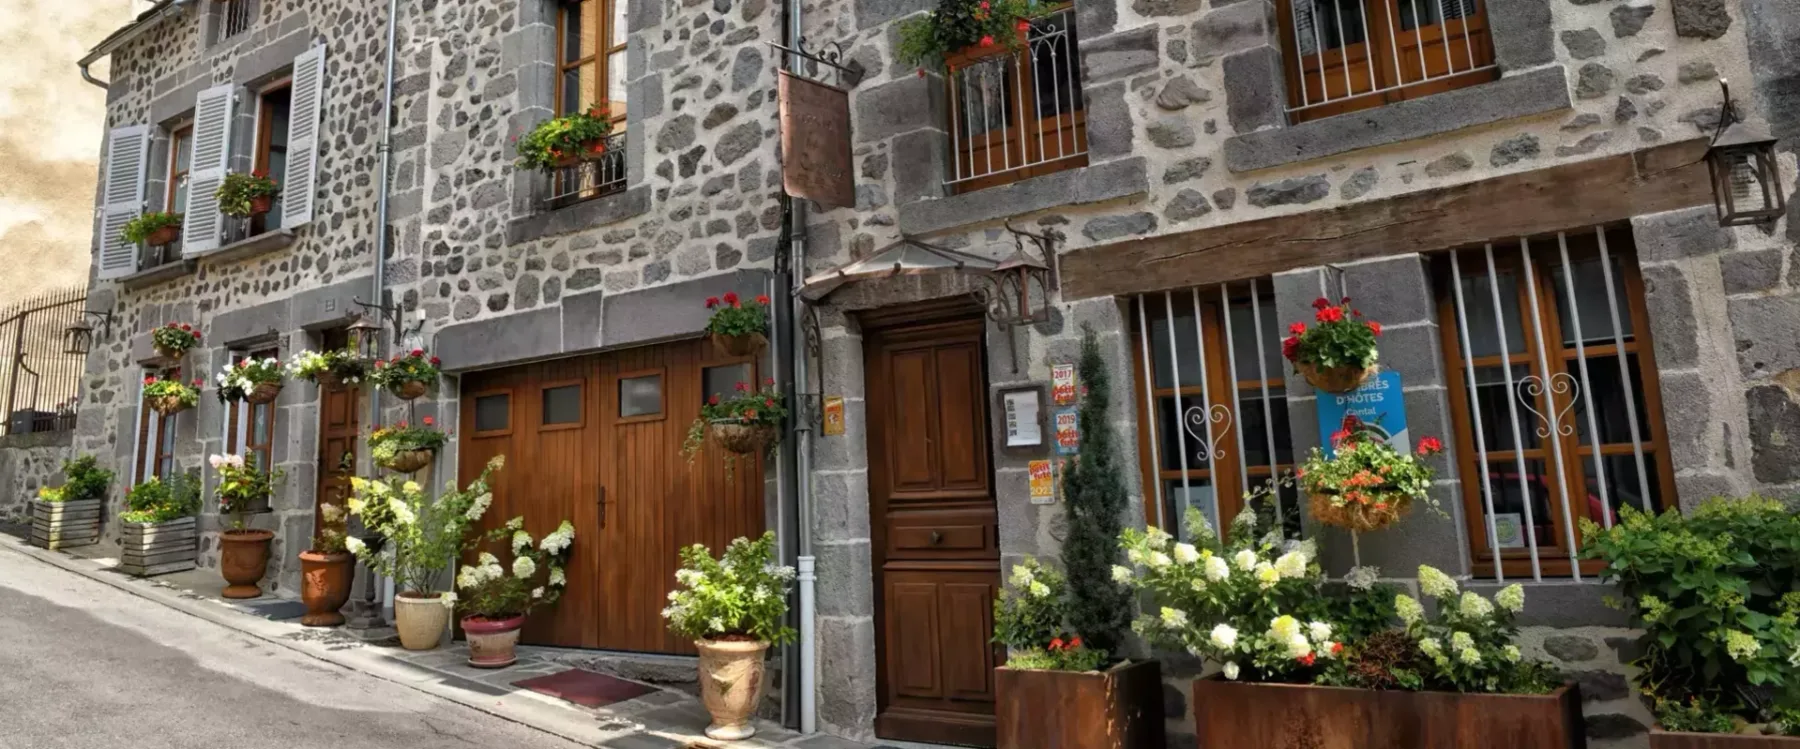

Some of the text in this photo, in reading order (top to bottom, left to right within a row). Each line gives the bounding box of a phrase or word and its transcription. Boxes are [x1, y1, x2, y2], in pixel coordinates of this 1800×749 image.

[1054, 370, 1072, 379] 2017
[1336, 392, 1384, 405] D'HÔTES
[1346, 407, 1376, 416] Cantal
[1058, 415, 1075, 425] 2019
